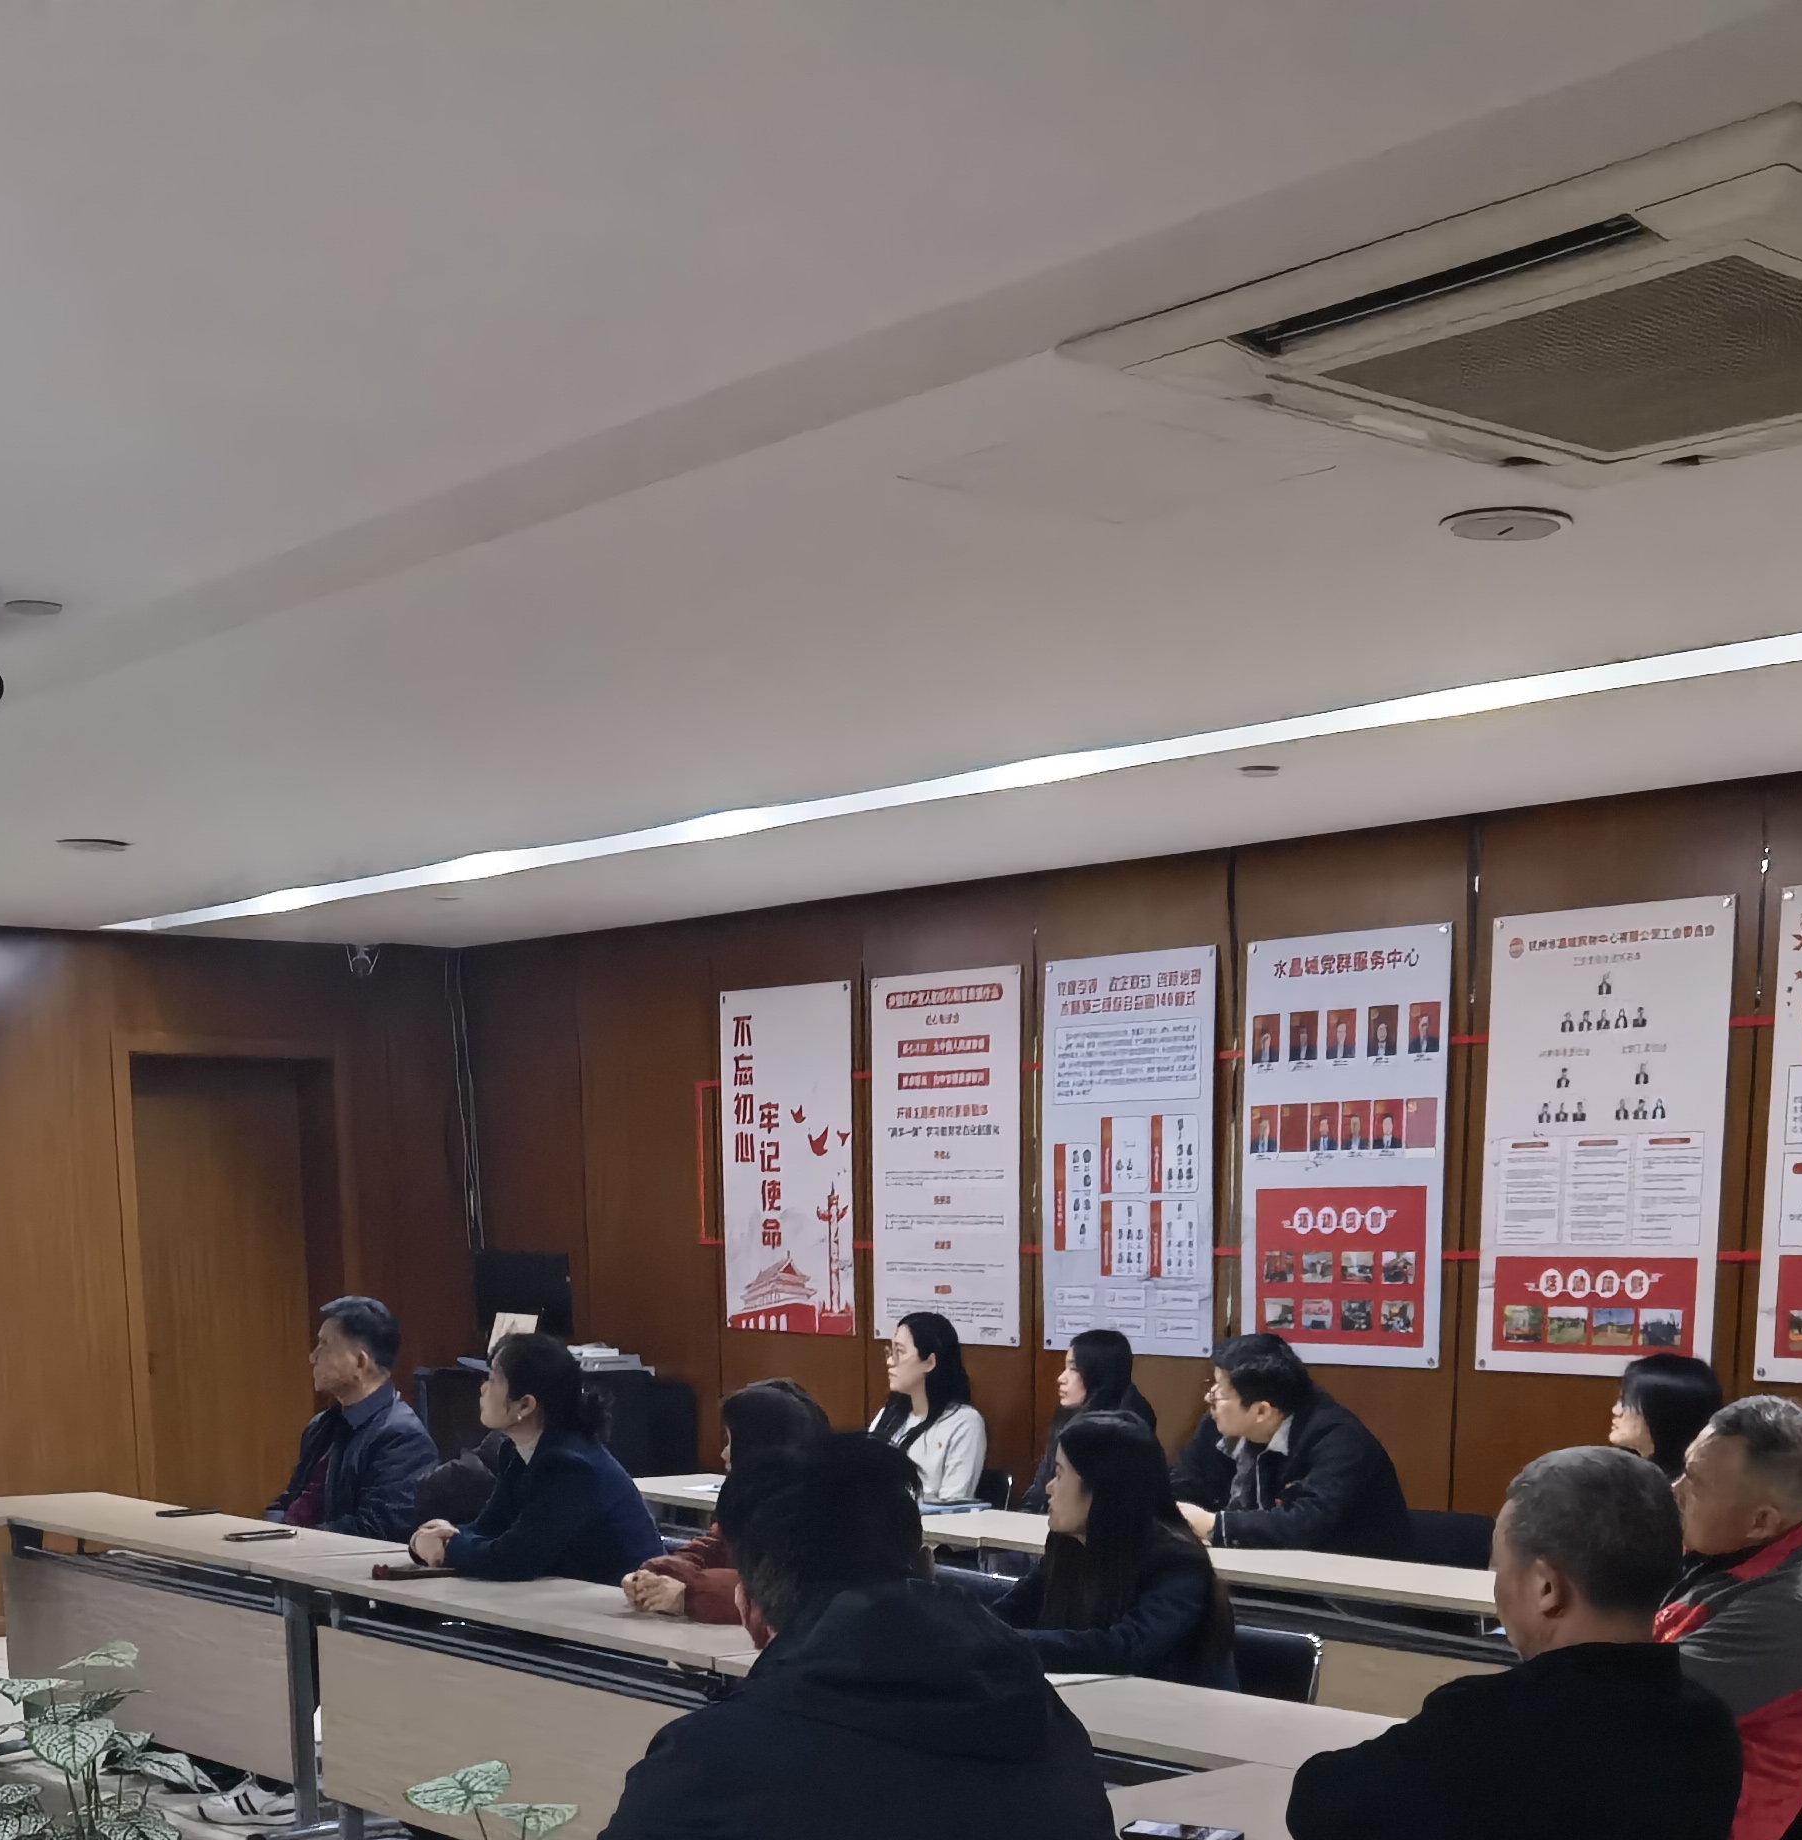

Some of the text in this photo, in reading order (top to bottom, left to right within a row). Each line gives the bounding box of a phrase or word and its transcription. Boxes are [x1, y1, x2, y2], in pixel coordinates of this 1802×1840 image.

[732, 1015, 756, 1164] 不忘初心
[758, 1100, 782, 1251] 牢记使命
